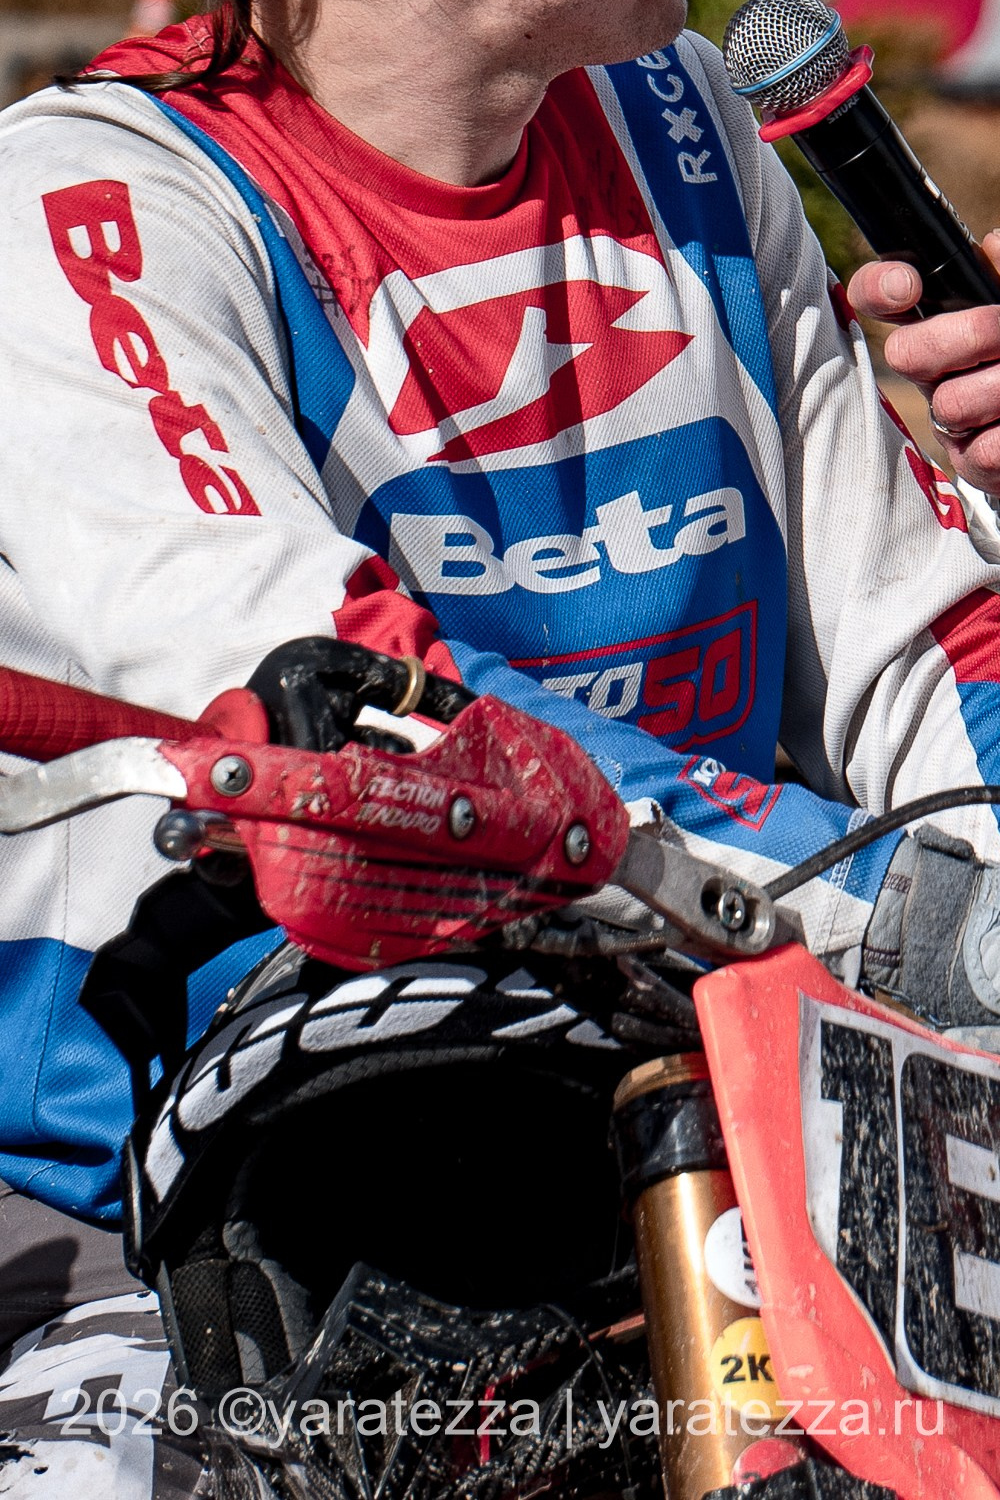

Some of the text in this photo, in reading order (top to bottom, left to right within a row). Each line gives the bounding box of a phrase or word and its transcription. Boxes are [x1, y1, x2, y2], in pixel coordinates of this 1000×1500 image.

[826, 93, 860, 125] SHURE
[41, 179, 262, 517] Beta
[389, 485, 746, 596] Beta
